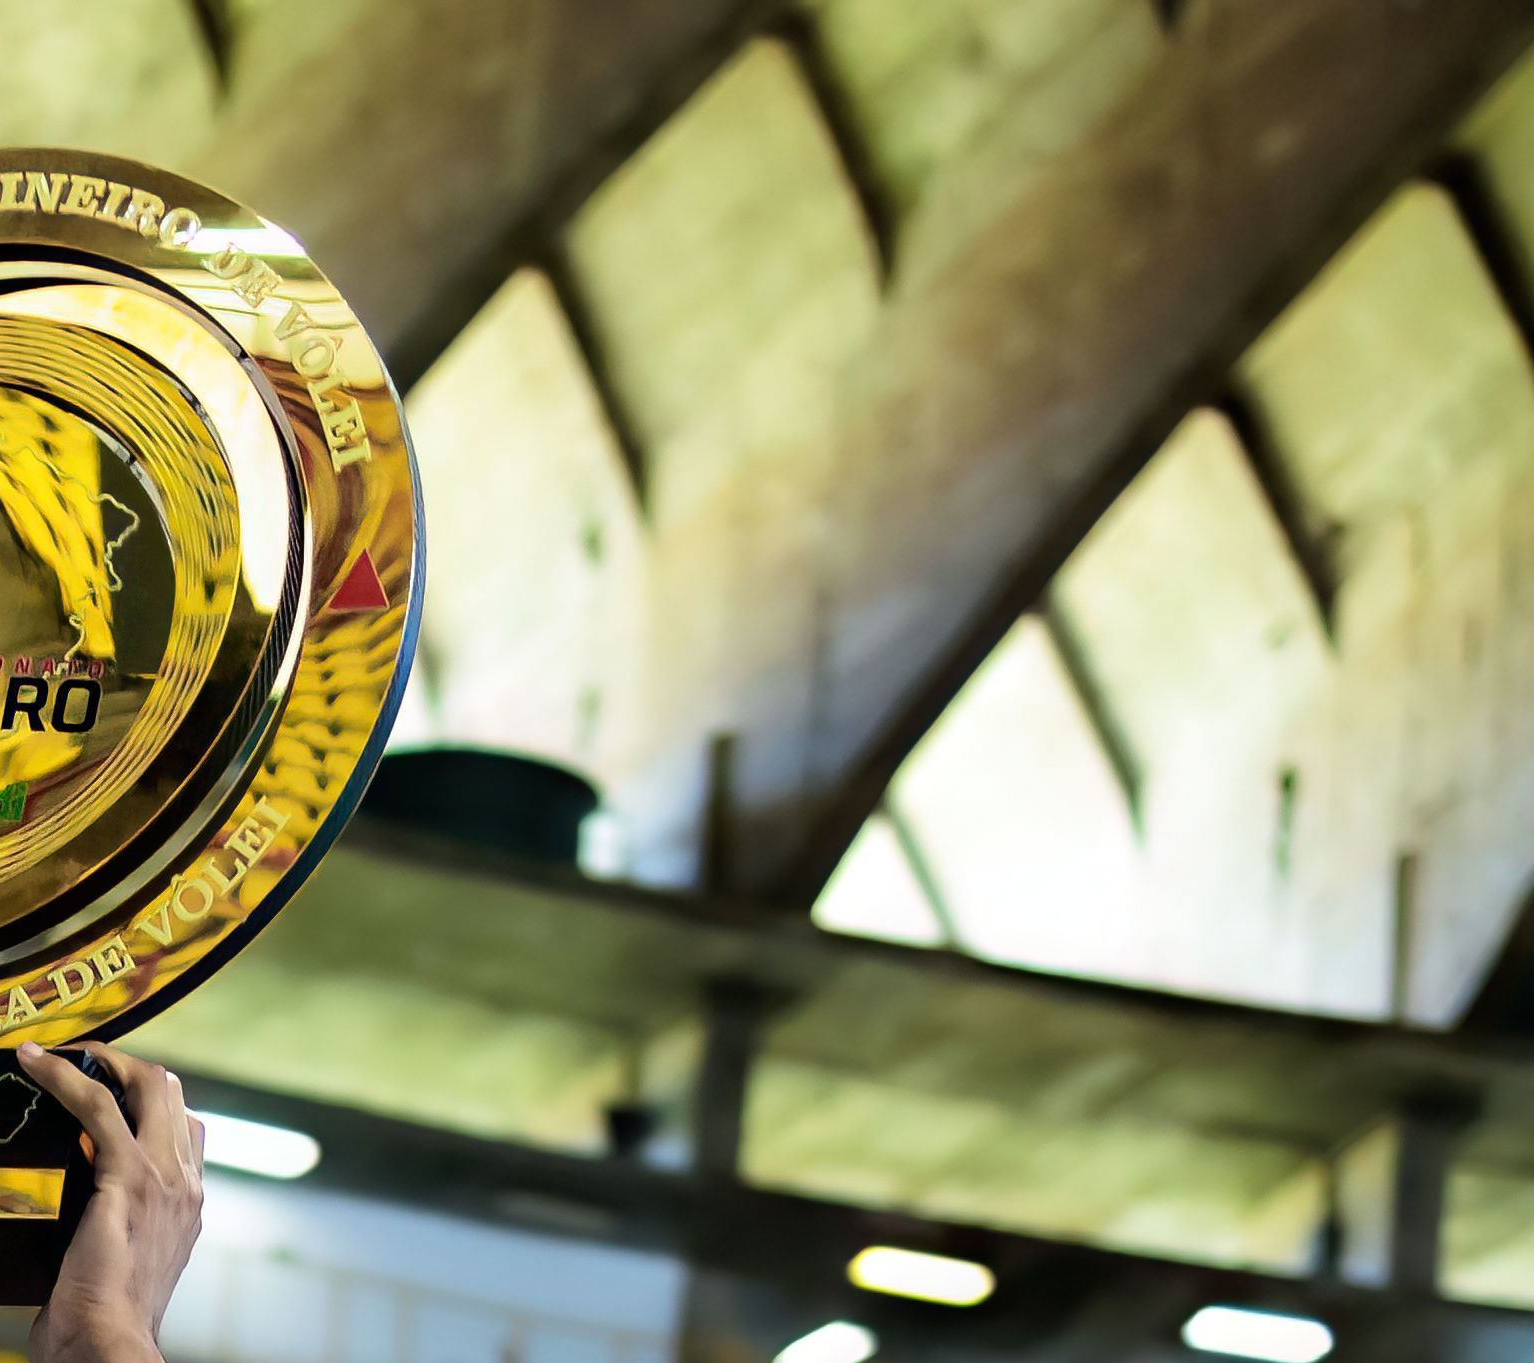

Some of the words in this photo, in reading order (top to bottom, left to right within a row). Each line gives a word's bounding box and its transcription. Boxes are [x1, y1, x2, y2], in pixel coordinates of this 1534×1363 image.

[199, 240, 283, 307] DE
[276, 301, 374, 474] VÔLEI
[46, 936, 138, 1007] DE
[133, 795, 293, 949] VÔLEI
